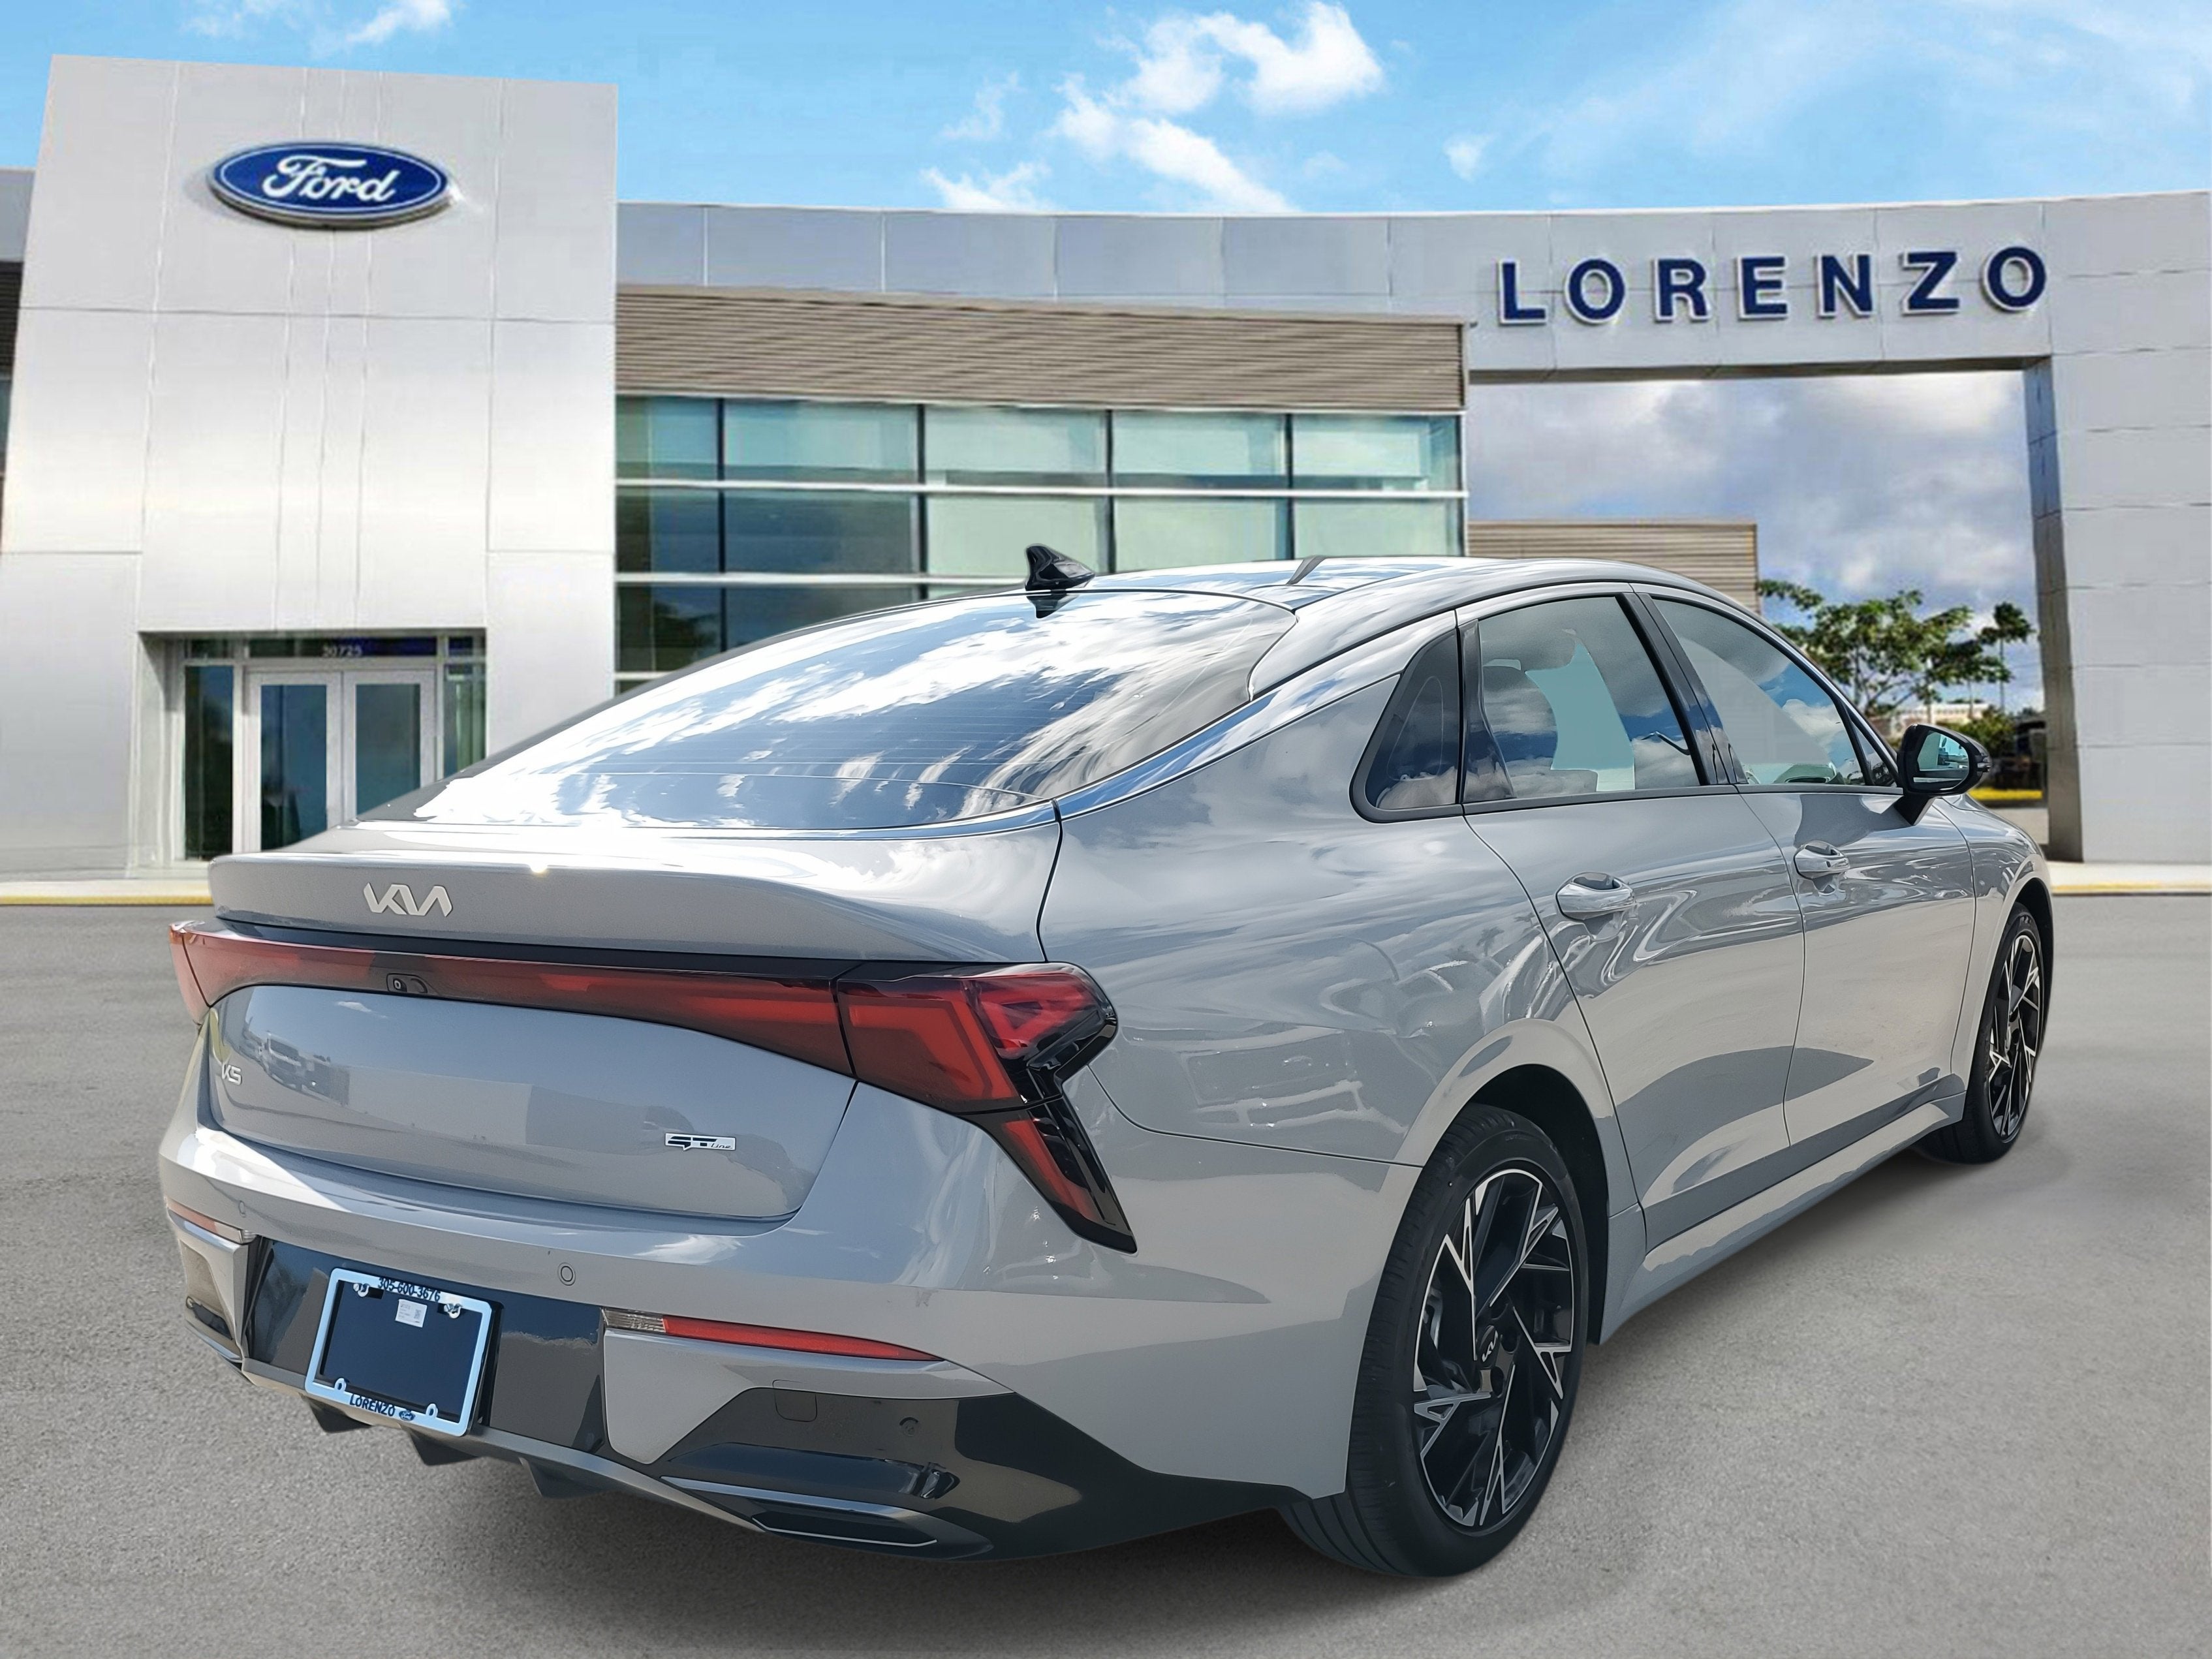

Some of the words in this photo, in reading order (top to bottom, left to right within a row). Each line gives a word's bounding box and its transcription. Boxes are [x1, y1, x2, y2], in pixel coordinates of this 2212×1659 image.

[262, 155, 400, 202] Ford
[1498, 245, 2048, 324] LORENZO
[363, 882, 452, 917] KIA
[377, 1277, 441, 1303] 305-600-3676
[349, 1393, 396, 1417] LORENZO
